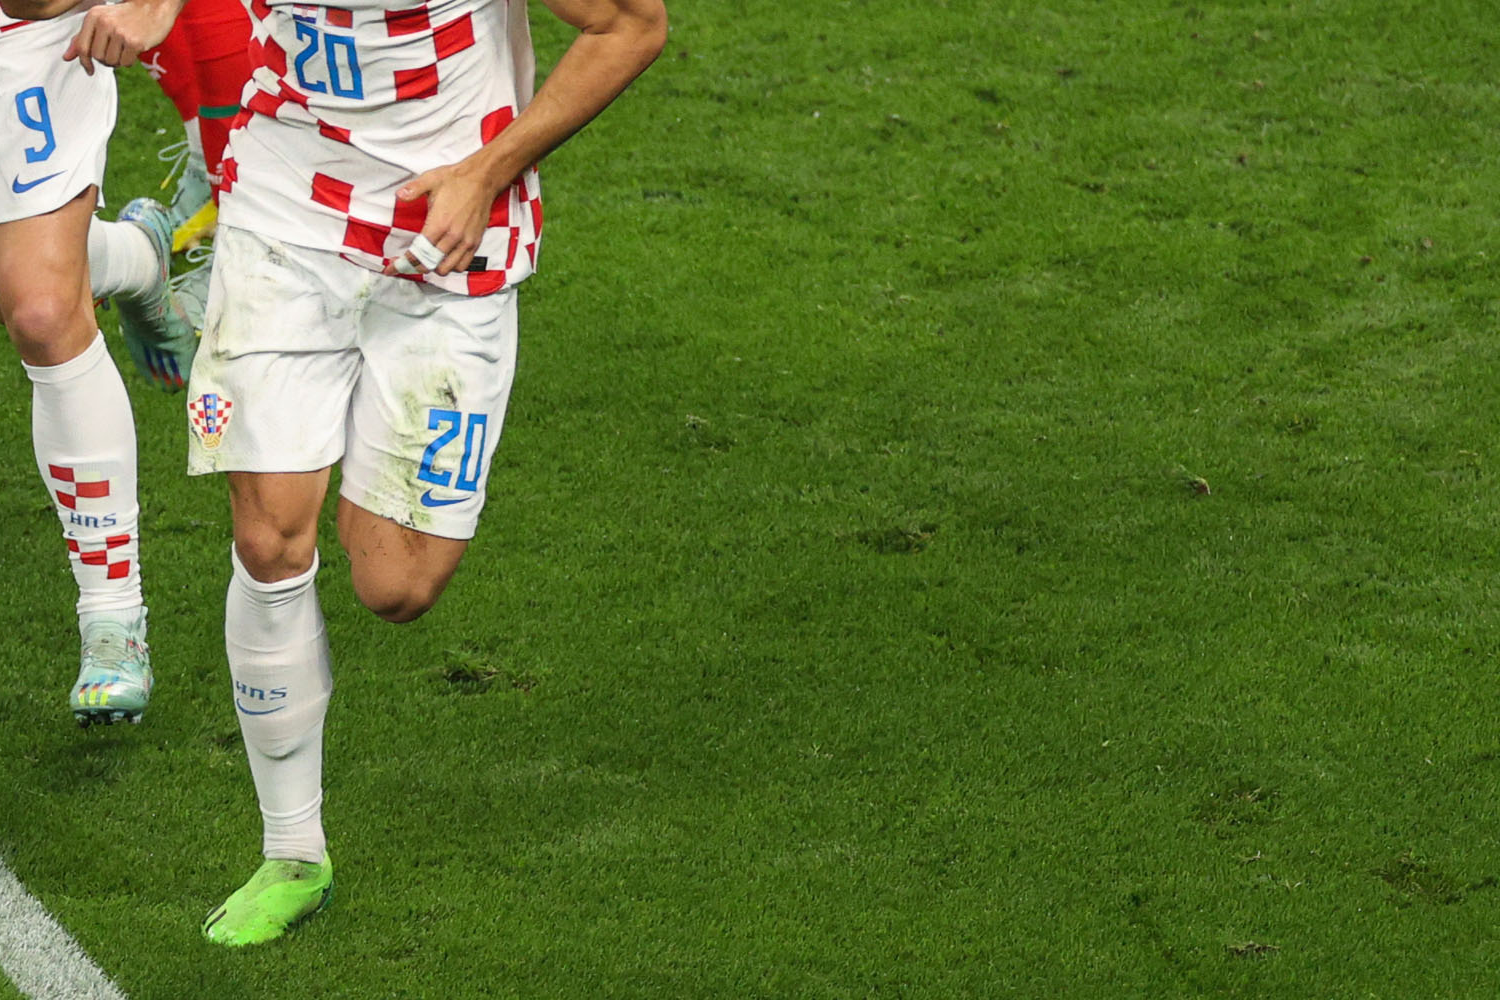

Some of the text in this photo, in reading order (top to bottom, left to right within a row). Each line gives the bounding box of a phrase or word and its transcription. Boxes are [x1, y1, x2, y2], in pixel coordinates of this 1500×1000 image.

[294, 20, 364, 100] 20
[15, 86, 56, 164] 9
[417, 408, 487, 492] 20
